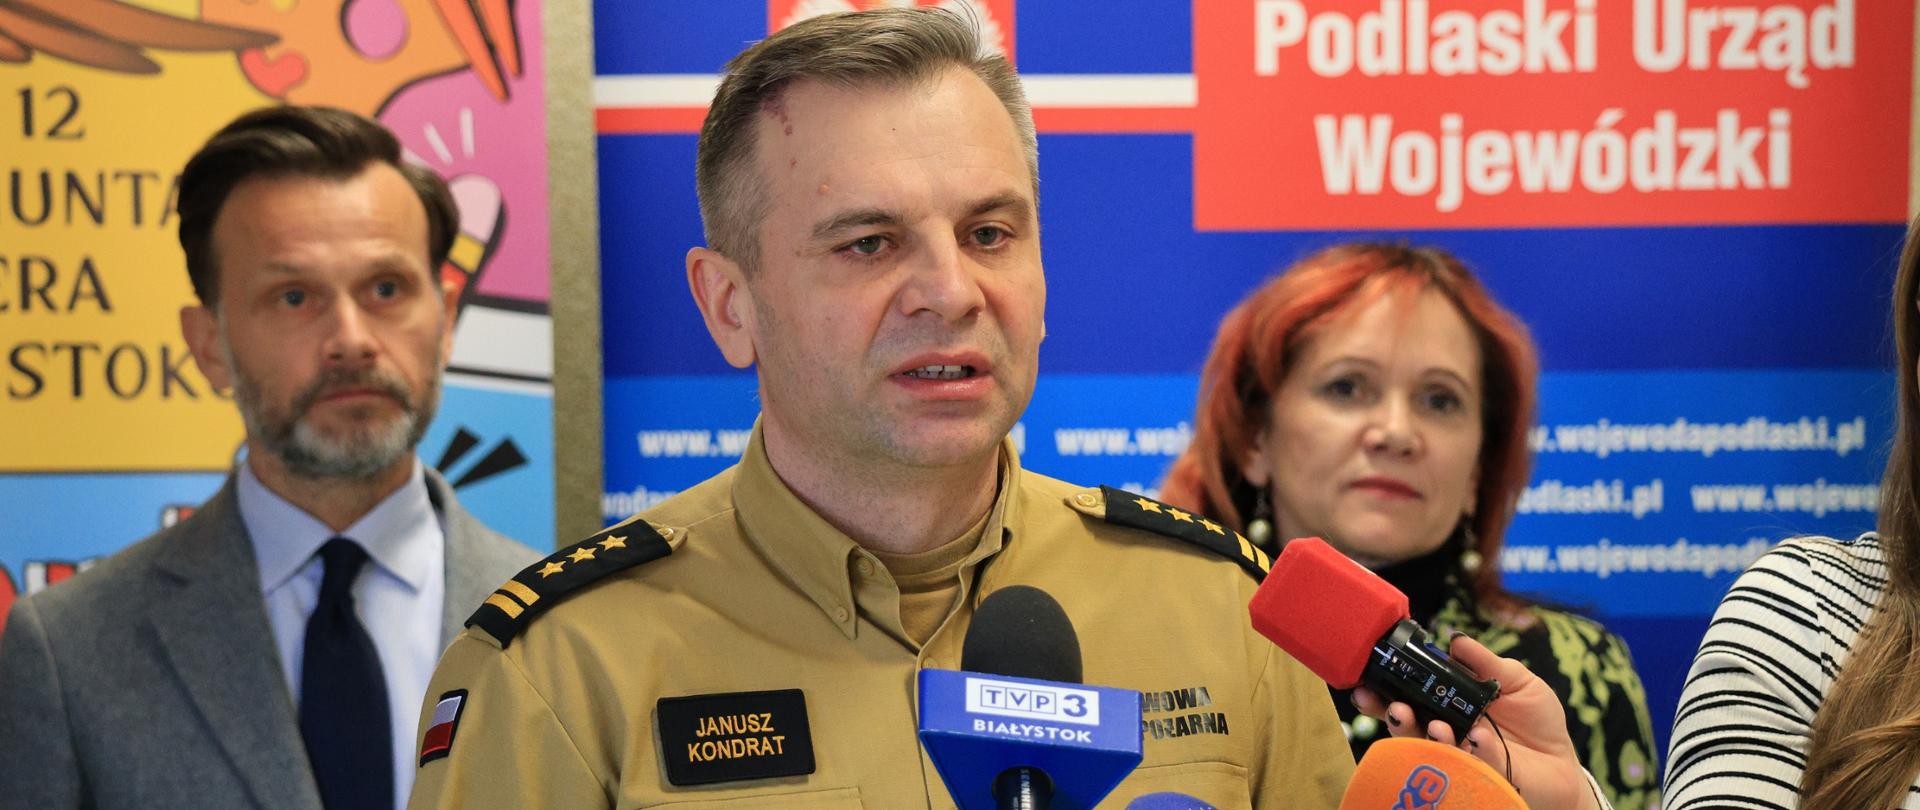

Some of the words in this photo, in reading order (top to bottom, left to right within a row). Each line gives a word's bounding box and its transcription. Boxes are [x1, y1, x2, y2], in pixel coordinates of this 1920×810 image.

[1254, 0, 1598, 77] Podlaski
[1632, 0, 1856, 89] Urząd
[19, 85, 84, 140] 12
[1313, 107, 1792, 213] Wojewódzki
[8, 342, 234, 400] STOK
[1512, 479, 1664, 519] odlaski.pl
[695, 712, 775, 738] JANUSZ
[973, 718, 1092, 744] BIAŁYSTOK
[687, 735, 786, 763] KONDRAT
